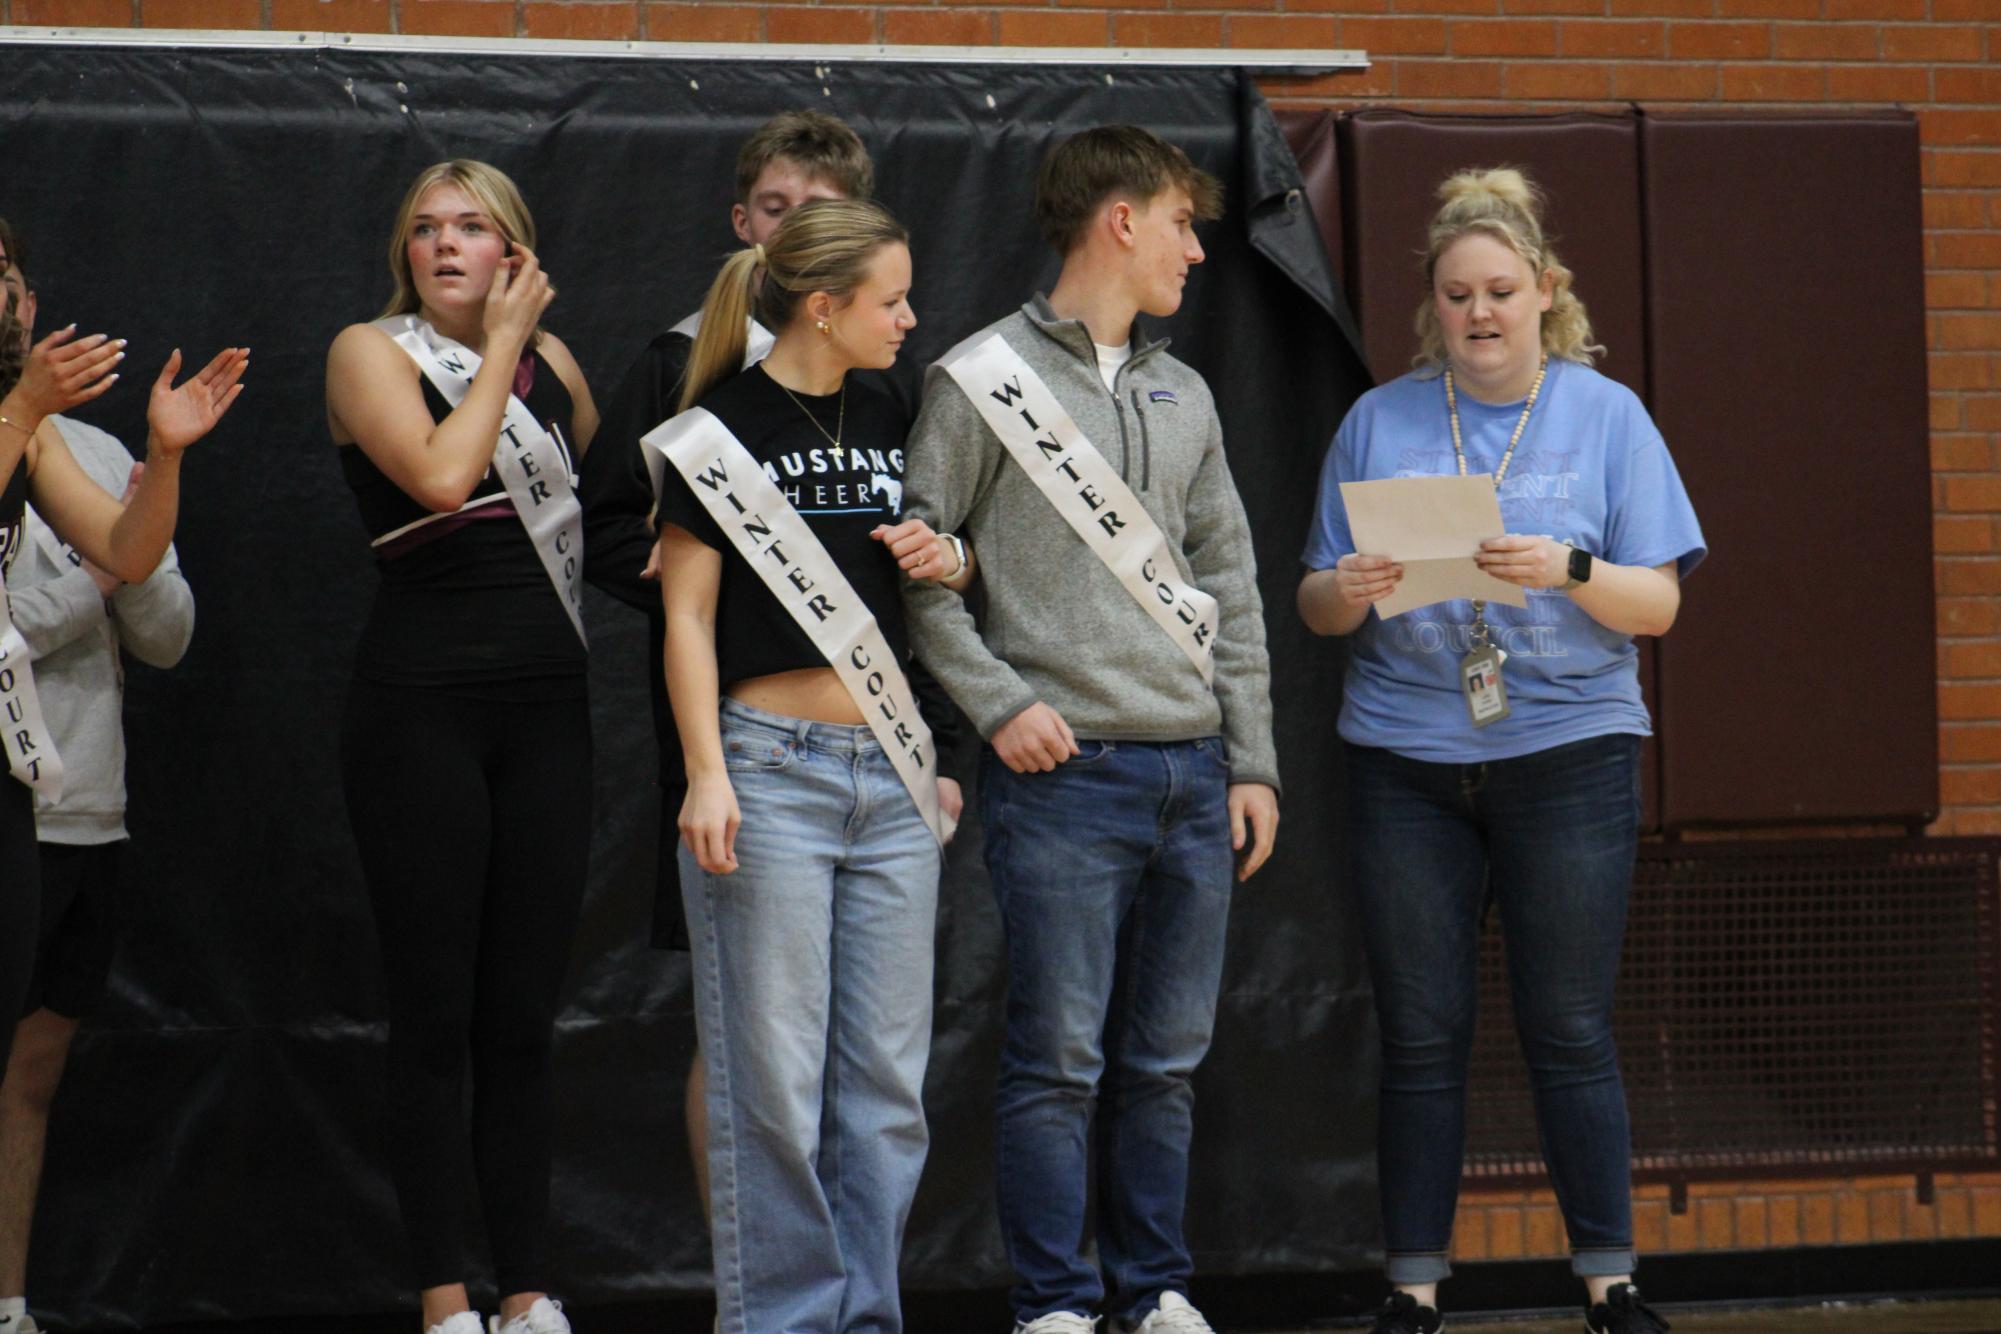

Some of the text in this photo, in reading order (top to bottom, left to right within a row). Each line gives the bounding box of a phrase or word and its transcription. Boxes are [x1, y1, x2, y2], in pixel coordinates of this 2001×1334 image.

[439, 352, 552, 506] WTER
[783, 483, 871, 505] HEER
[990, 375, 1126, 538] WINTER
[696, 457, 926, 770] WINTER COURT
